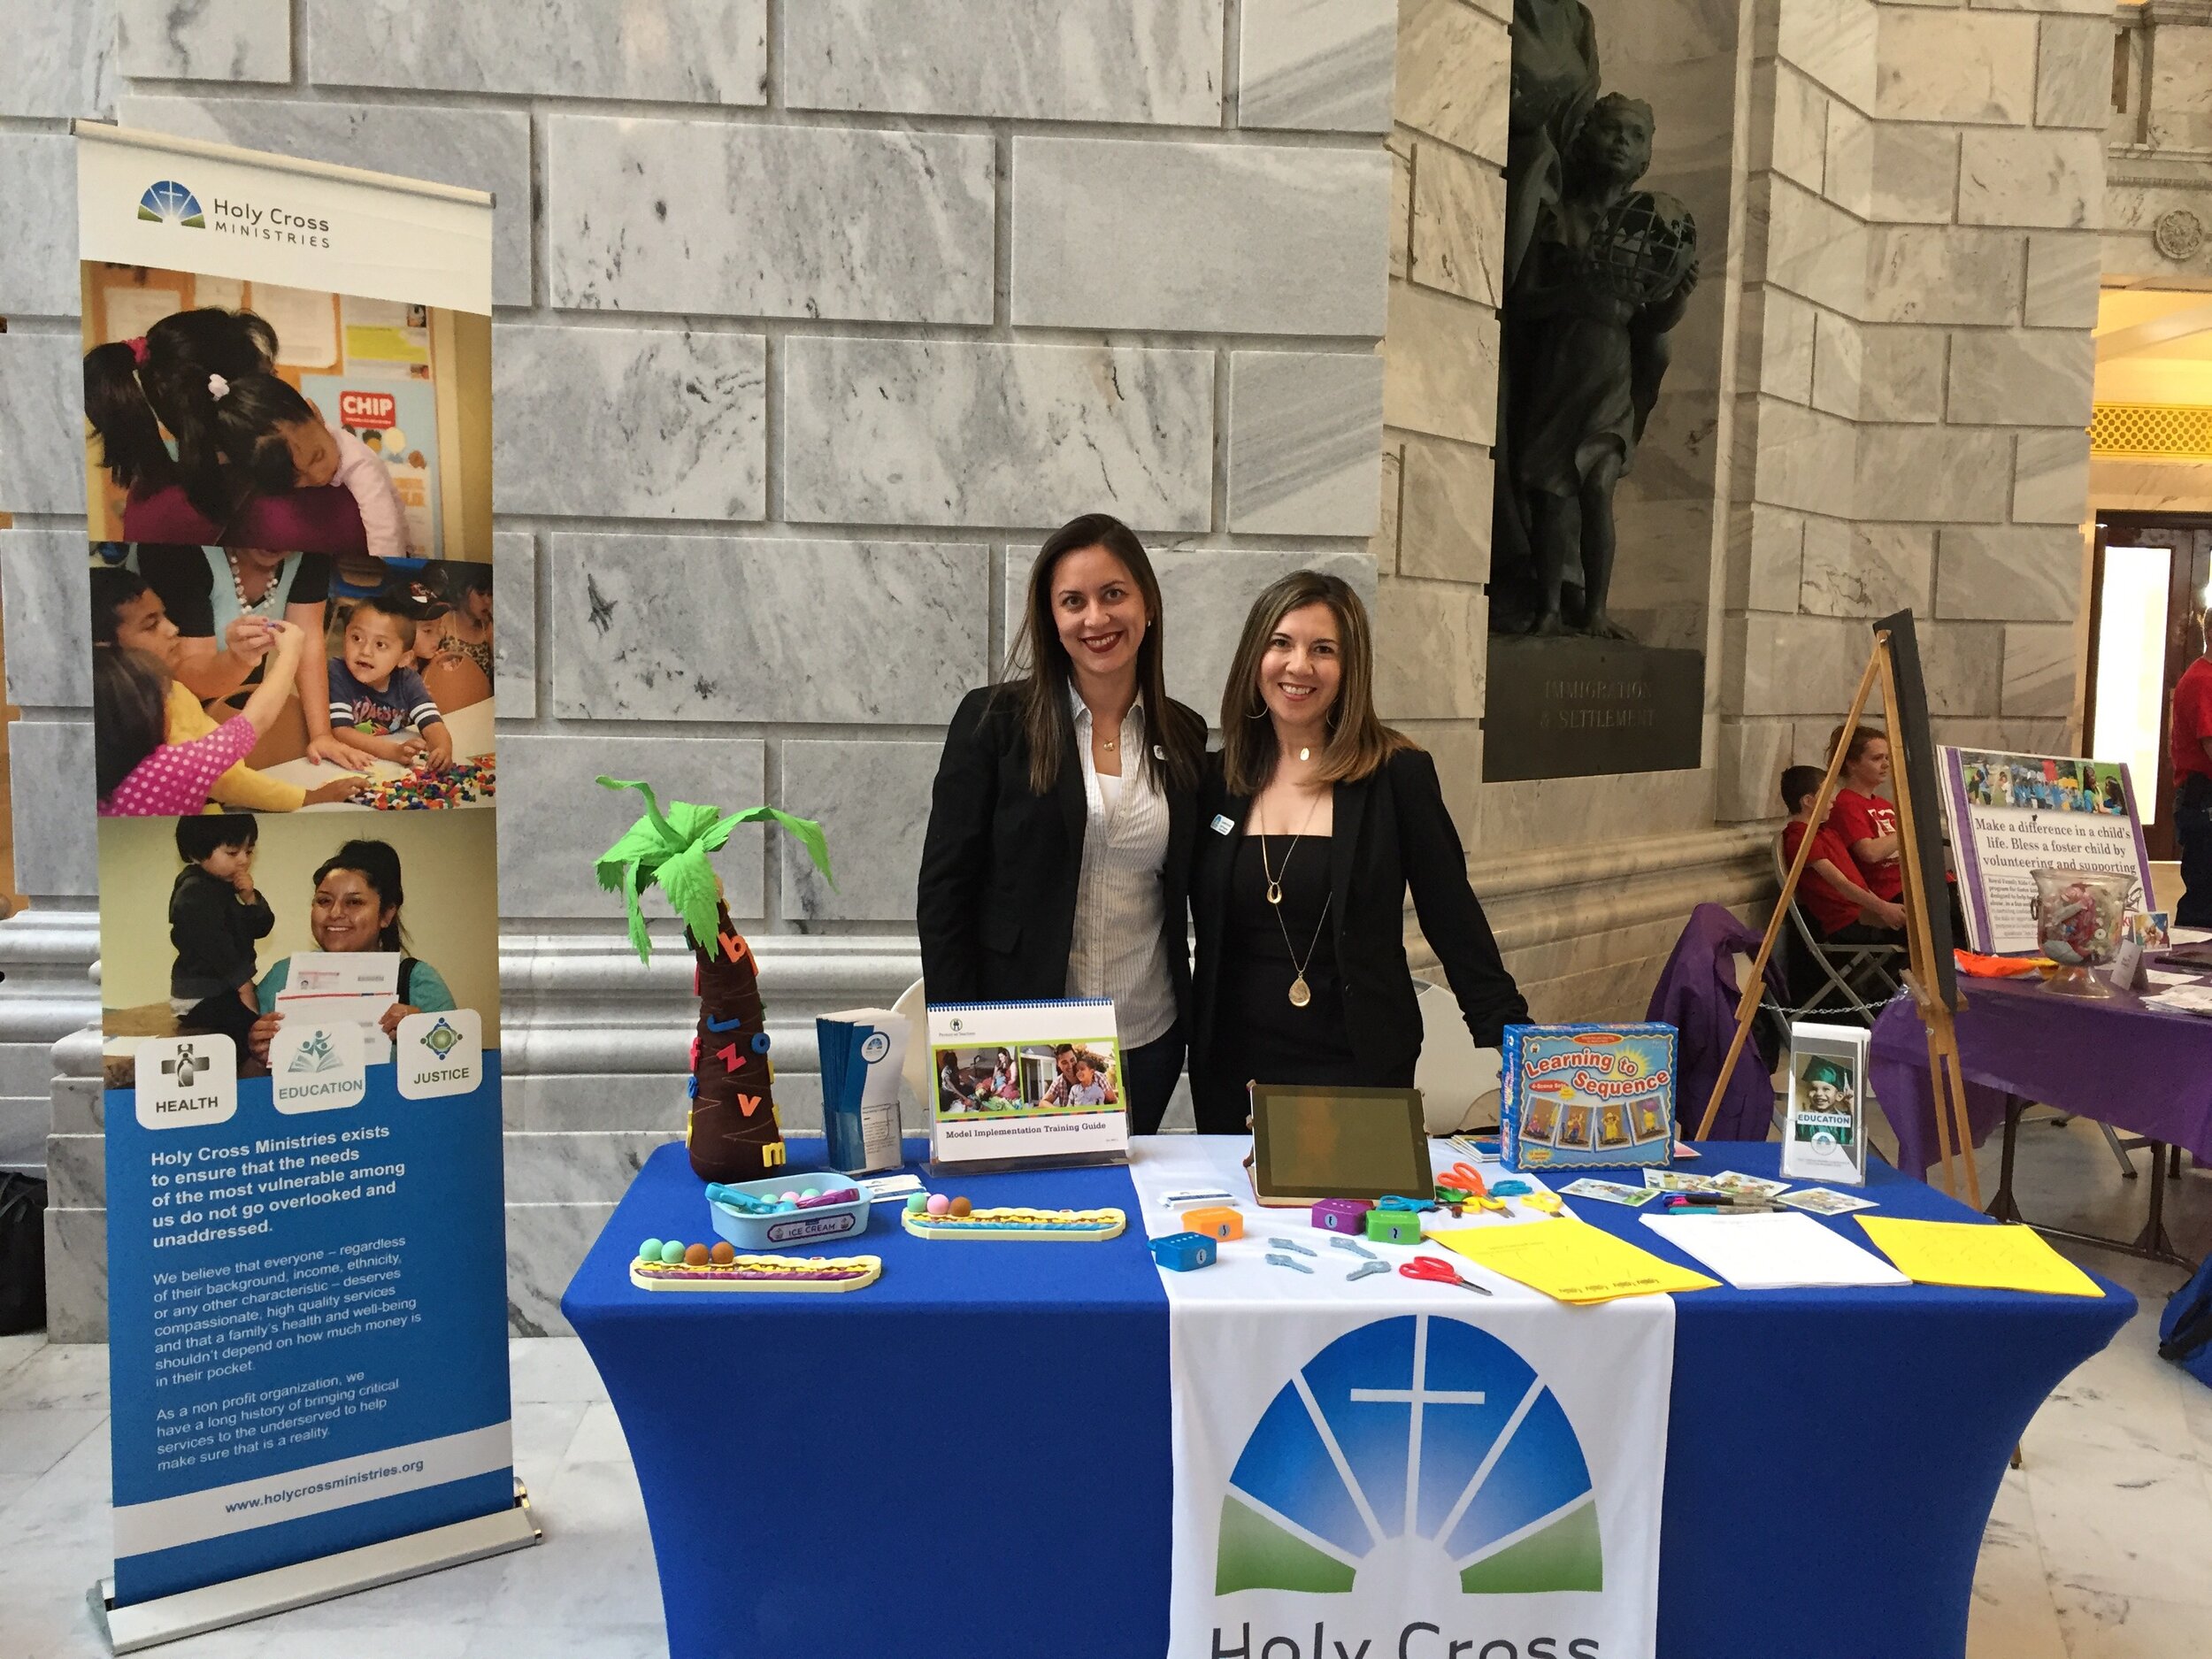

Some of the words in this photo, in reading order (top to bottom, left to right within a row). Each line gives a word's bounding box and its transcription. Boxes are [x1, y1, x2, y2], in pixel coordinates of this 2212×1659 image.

[215, 199, 262, 225] Holy
[271, 209, 329, 231] Cross
[215, 221, 330, 248] MINISTRIES
[342, 396, 393, 416] CHIP
[1975, 818, 2006, 831] Make
[2009, 823, 2015, 832] a
[2018, 821, 2072, 835] difference
[2076, 826, 2085, 836] in
[2098, 827, 2131, 840] child's
[1987, 837, 2008, 849] life.
[2012, 838, 2039, 850] Bless
[2052, 841, 2081, 853] foster
[2085, 842, 2111, 855] child
[2114, 847, 2126, 856] by
[1983, 856, 2053, 868] volunteering
[2057, 860, 2076, 870] and
[414, 1068, 470, 1084] JUSTICE
[1525, 1048, 1614, 1077] Learning
[1619, 1058, 1636, 1074] to
[279, 1079, 363, 1100] EDUCATION
[1574, 1071, 1670, 1099] Sequence
[156, 1096, 219, 1113] HEALTH
[1798, 1114, 1849, 1124] EDUCATION
[151, 1150, 193, 1166] Holy
[198, 1144, 250, 1161] Cross
[256, 1131, 336, 1154] Ministries
[342, 1125, 389, 1141] exists
[974, 1126, 1042, 1138] Implementation
[1044, 1124, 1079, 1133] Training
[151, 1173, 170, 1187] to
[175, 1165, 236, 1184] ensure
[242, 1160, 274, 1175] that
[280, 1156, 304, 1170] the
[311, 1148, 359, 1166] needs
[152, 1194, 171, 1207] of
[176, 1189, 204, 1204] the
[209, 1182, 253, 1201] most
[258, 1170, 345, 1193] vulnerable
[350, 1163, 405, 1179] among
[152, 1214, 175, 1228] us
[180, 1210, 204, 1225] do
[209, 1205, 237, 1221] not
[242, 1203, 264, 1219] go
[269, 1187, 361, 1211] overlooked
[366, 1180, 396, 1197] and
[153, 1220, 273, 1248] unaddressed.
[805, 1224, 835, 1233] CREAM
[153, 1273, 177, 1286] We
[181, 1265, 231, 1282] believe
[235, 1261, 260, 1274] that
[265, 1250, 324, 1269] everyone
[340, 1238, 405, 1256] regardless
[154, 1293, 169, 1302] of
[173, 1286, 202, 1301] their
[207, 1273, 288, 1294] background,
[293, 1263, 343, 1280] income,
[154, 1309, 169, 1320] or
[173, 1306, 197, 1317] any
[203, 1298, 237, 1313] other
[242, 1282, 328, 1306] characteristic
[343, 1270, 401, 1286] deserves
[155, 1311, 262, 1337] compassionate,
[267, 1305, 294, 1319] high
[299, 1295, 340, 1312] quality
[343, 1286, 396, 1303] services
[155, 1340, 180, 1354] and
[186, 1334, 211, 1349] that
[216, 1333, 224, 1344] a
[229, 1325, 279, 1344] family's
[282, 1314, 321, 1332] health
[326, 1311, 349, 1326] and
[353, 1299, 416, 1318] well-being
[156, 1349, 218, 1371] shouldn't
[223, 1340, 272, 1360] depend
[276, 1337, 293, 1349] on
[297, 1329, 323, 1344] how
[326, 1324, 362, 1339] much
[365, 1315, 406, 1332] money
[411, 1313, 421, 1323] is
[156, 1376, 167, 1387] in
[173, 1369, 203, 1384] their
[157, 1409, 174, 1420] As
[180, 1407, 188, 1417] a
[193, 1402, 218, 1414] non
[222, 1393, 257, 1409] profit
[260, 1379, 342, 1402] organization,
[346, 1371, 365, 1383] we
[157, 1424, 190, 1438] have
[196, 1420, 204, 1430] a
[208, 1414, 236, 1428] long
[242, 1403, 284, 1421] history
[289, 1400, 302, 1410] of
[305, 1388, 355, 1409] bringing
[359, 1379, 399, 1396] critical
[157, 1434, 214, 1455] services
[219, 1432, 231, 1441] to
[235, 1425, 257, 1439] the
[261, 1408, 341, 1434] underserved
[344, 1403, 357, 1415] to
[360, 1398, 387, 1415] help
[158, 1456, 196, 1471] make
[200, 1449, 230, 1463] sure
[234, 1440, 258, 1455] that
[264, 1438, 273, 1449] is
[278, 1437, 286, 1447] a
[226, 1460, 424, 1513] www.holycrossministries.org
